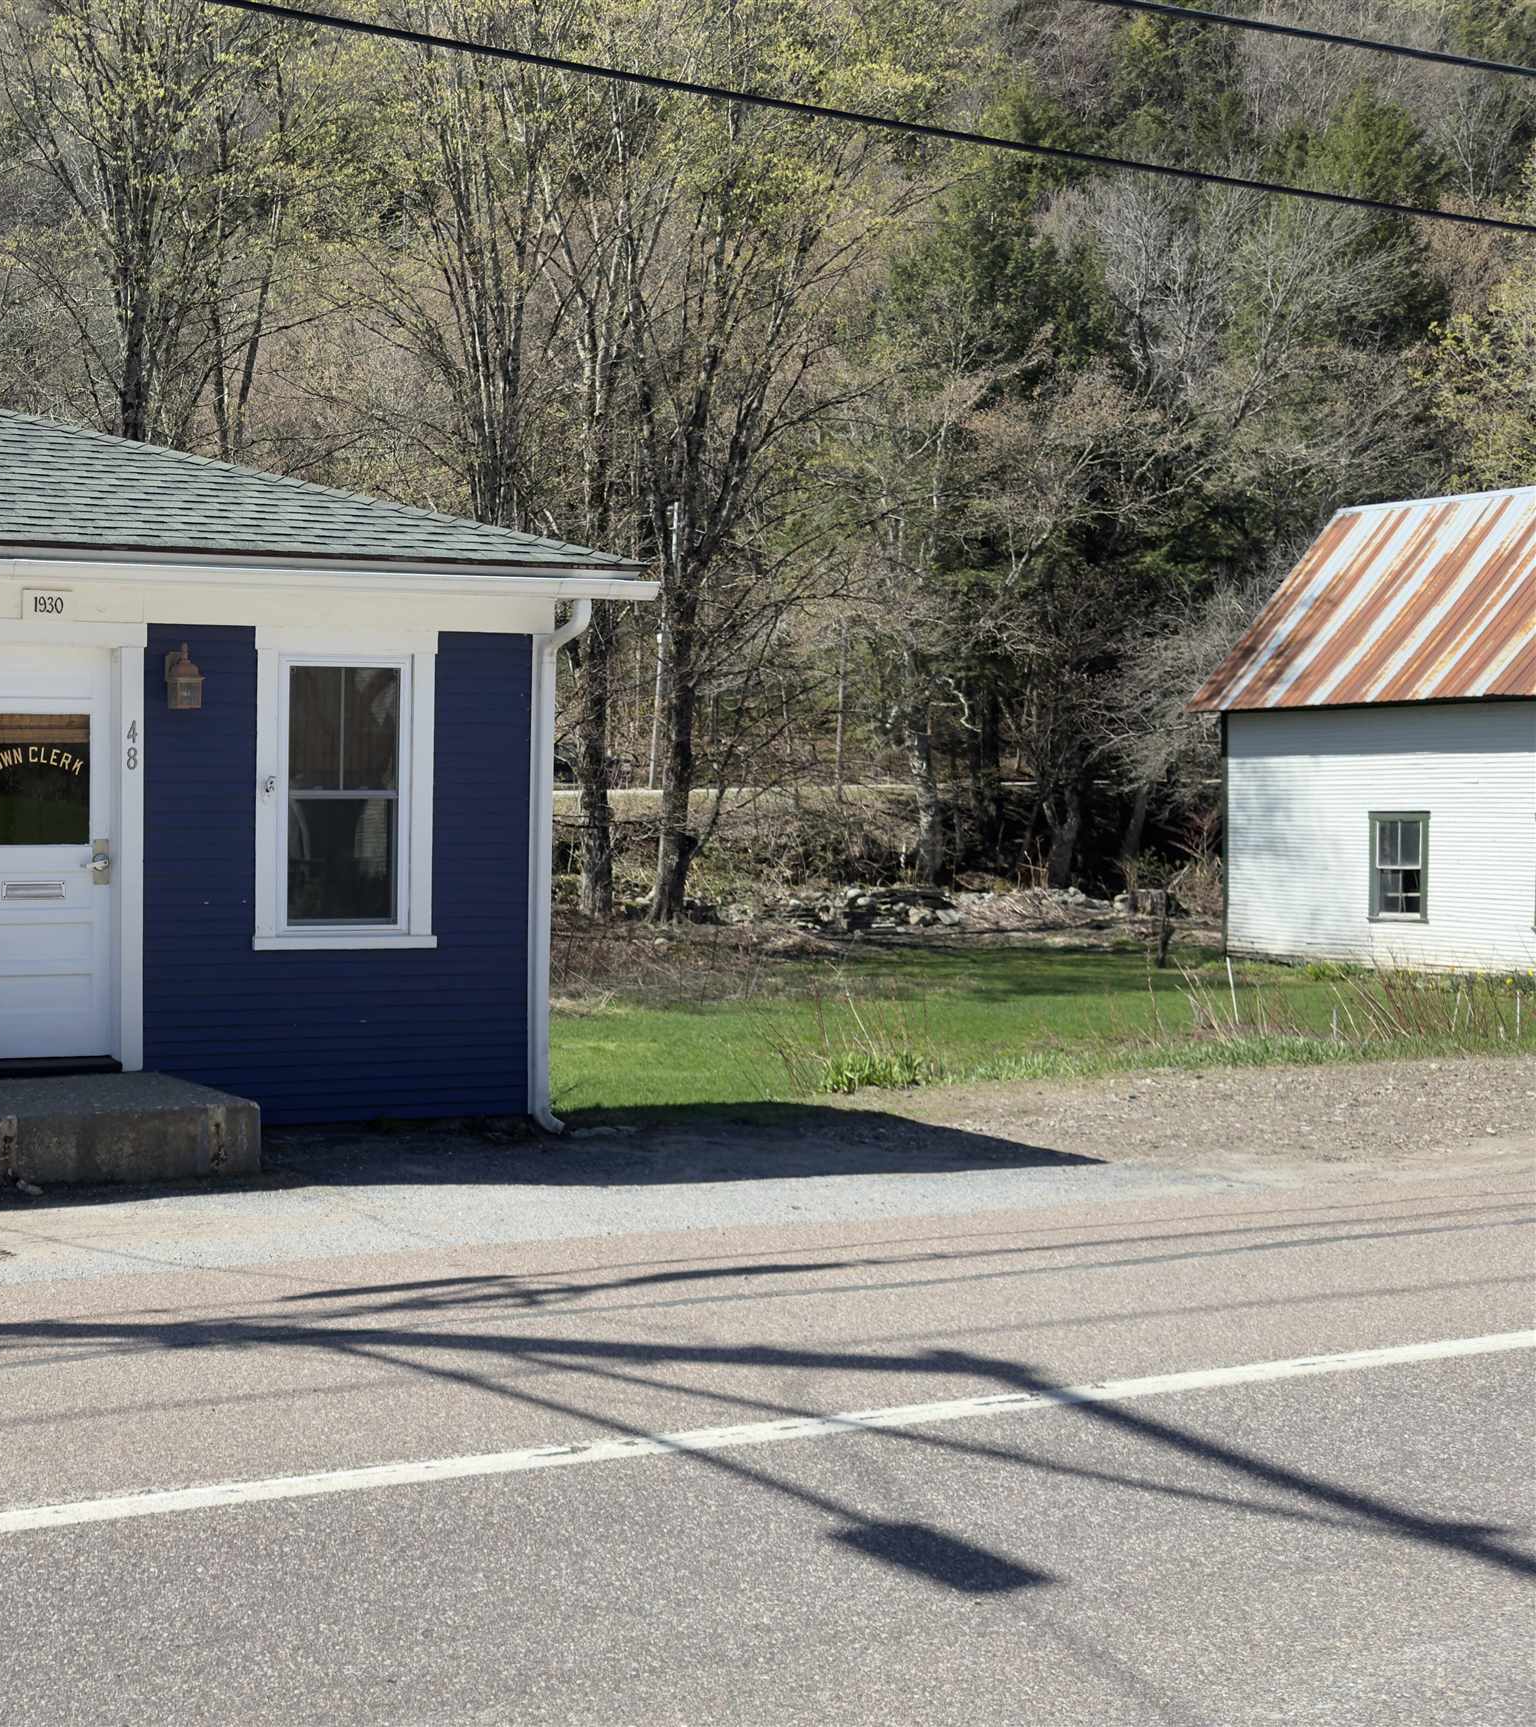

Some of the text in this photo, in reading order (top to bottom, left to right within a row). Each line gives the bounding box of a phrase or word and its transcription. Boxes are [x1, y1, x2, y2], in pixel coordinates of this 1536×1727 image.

[34, 596, 64, 614] 1930
[127, 720, 138, 770] 48
[29, 746, 84, 776] CLERK
